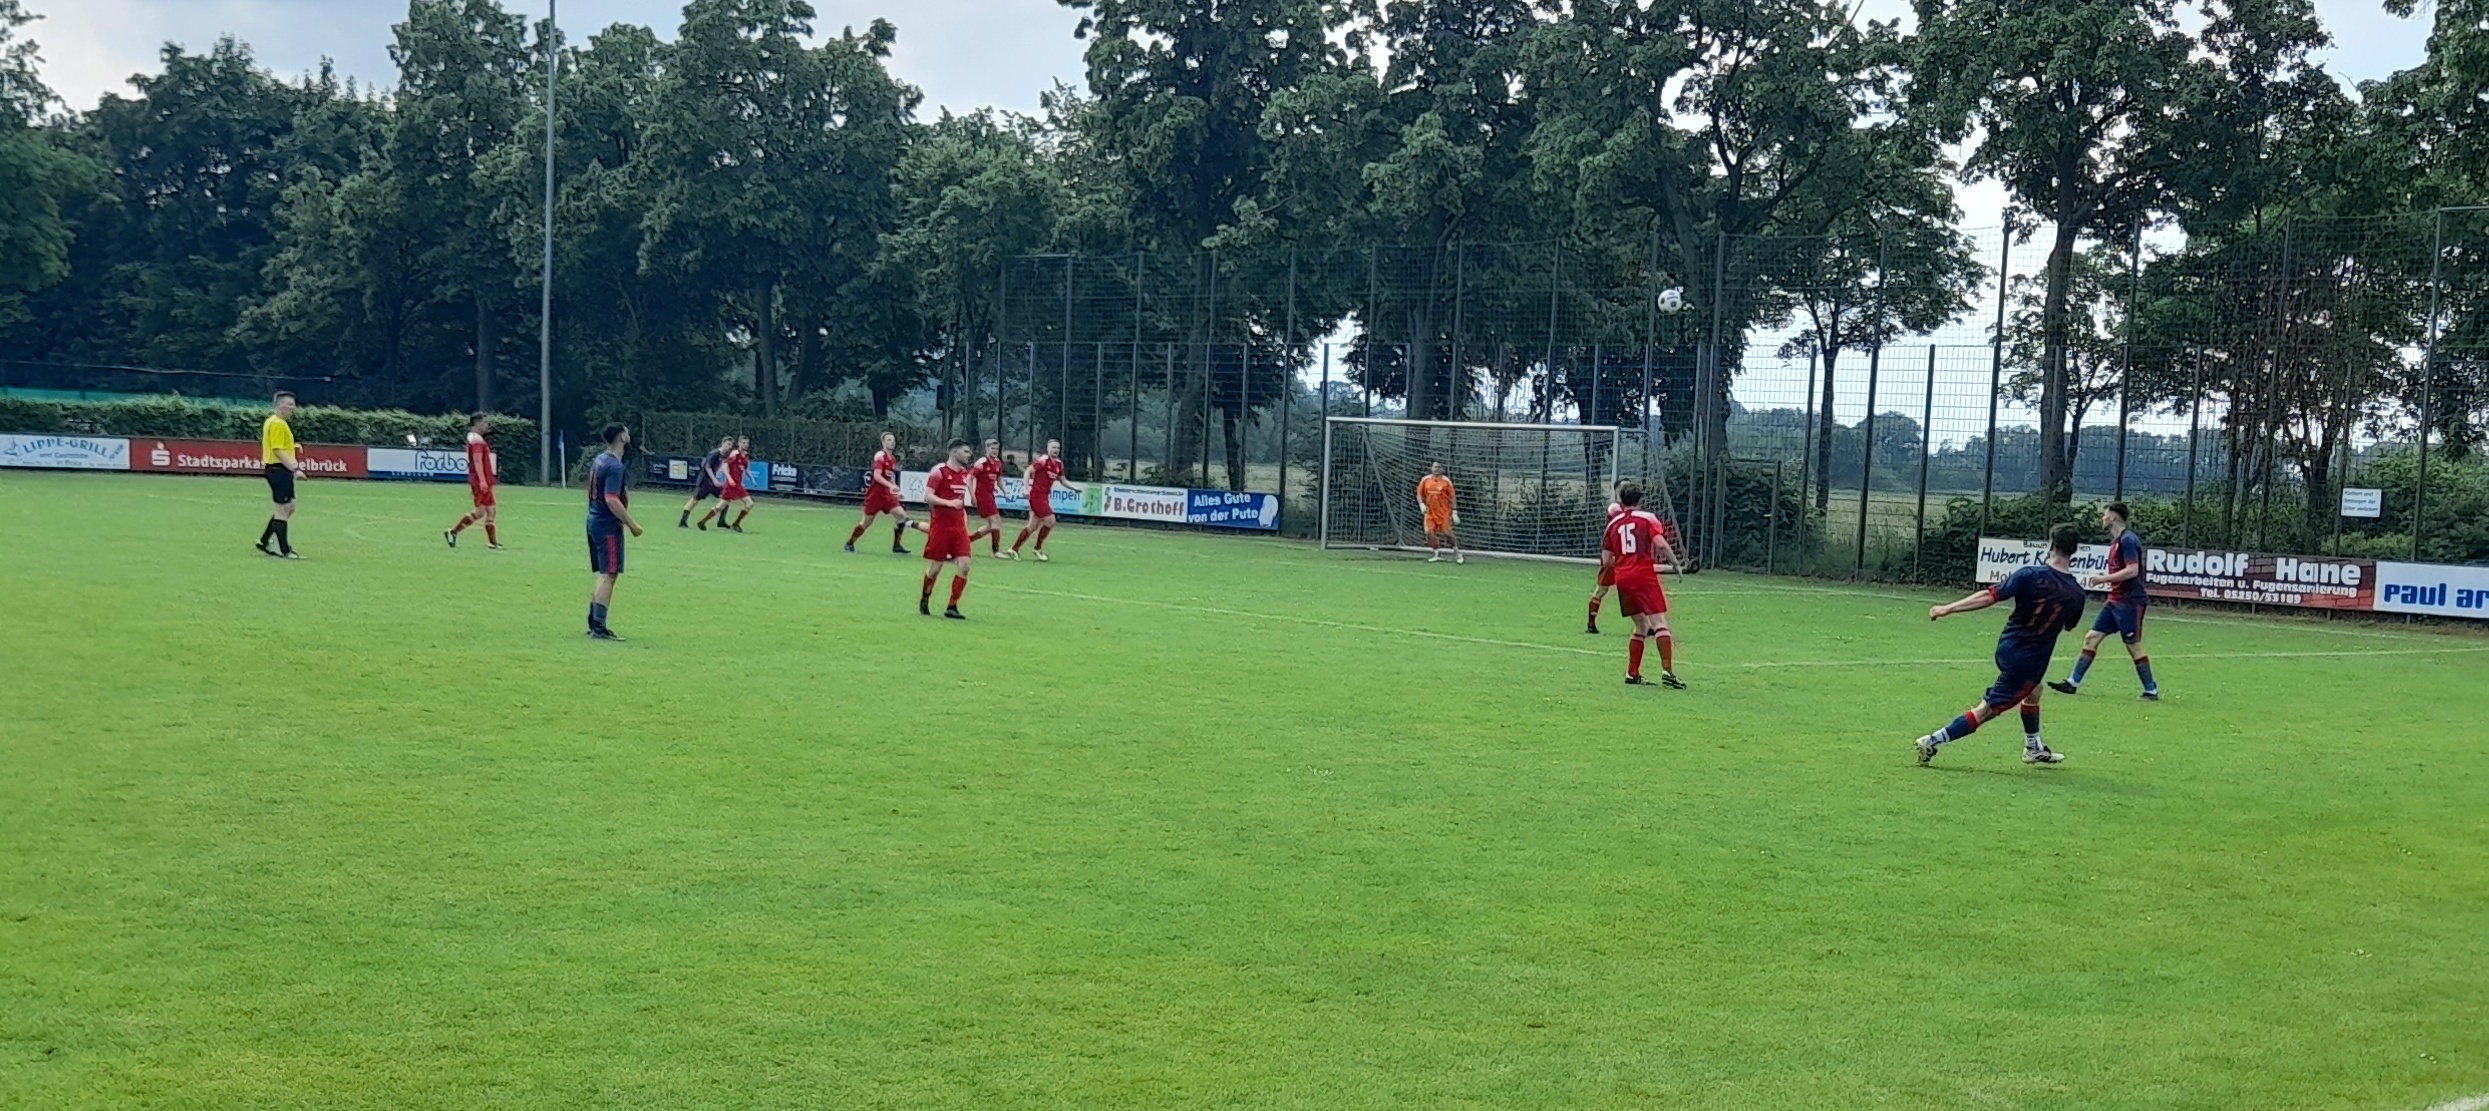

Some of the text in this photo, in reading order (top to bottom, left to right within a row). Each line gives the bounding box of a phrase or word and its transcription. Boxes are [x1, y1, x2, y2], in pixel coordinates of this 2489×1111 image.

[1194, 492, 1252, 508] Alles Gute
[1188, 513, 1208, 524] von
[1210, 510, 1229, 523] der
[1617, 522, 1637, 555] 15
[1980, 546, 2031, 566] Hubert
[2146, 549, 2361, 586] Rudolf Hane
[2146, 573, 2235, 588] Fugenarbeiten
[2252, 580, 2358, 598] Fugensanierung
[2200, 587, 2221, 599] Tel.
